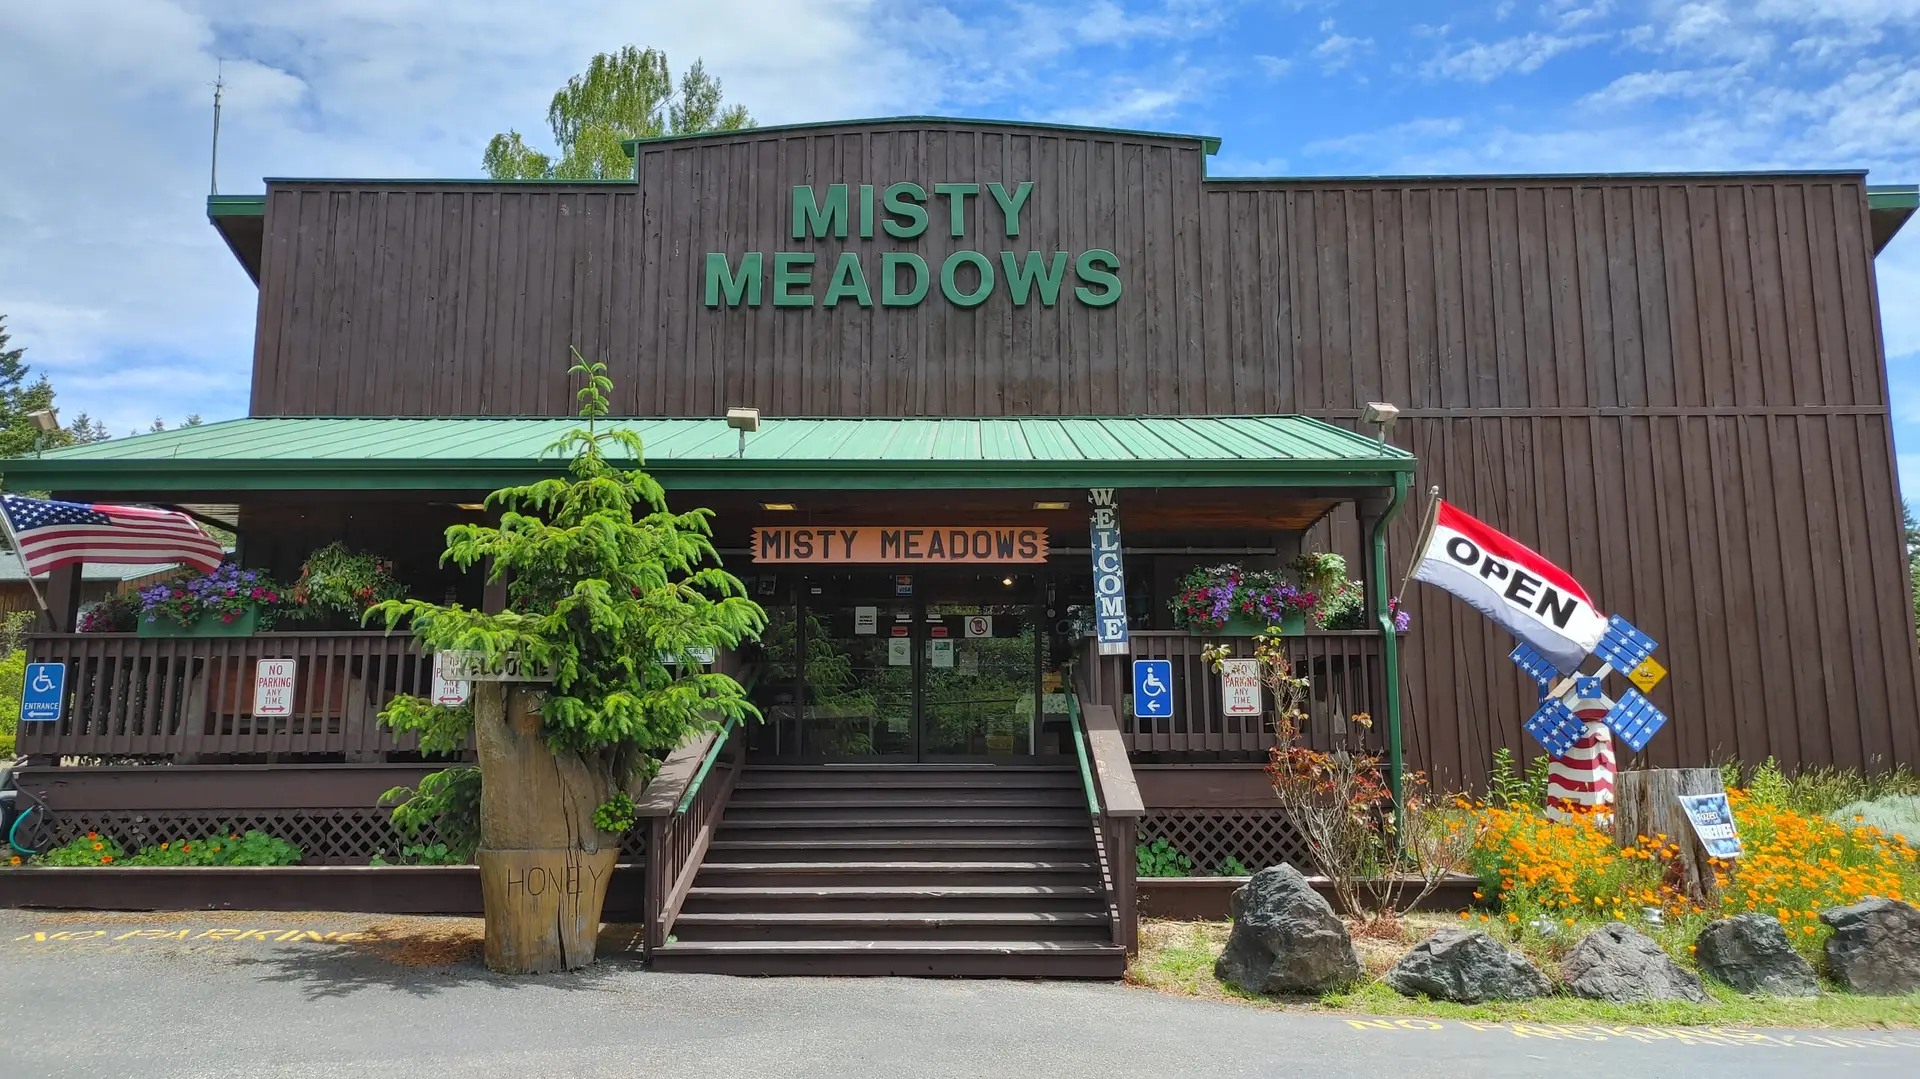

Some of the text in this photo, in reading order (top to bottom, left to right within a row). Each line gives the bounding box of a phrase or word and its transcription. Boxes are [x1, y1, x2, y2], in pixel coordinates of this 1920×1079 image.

[792, 181, 1034, 240] MISTY
[704, 248, 1122, 309] MEADOWS
[761, 530, 1039, 559] MISTY MEADOWS
[1090, 488, 1125, 640] WELCOME
[1446, 536, 1579, 629] OPEN
[268, 665, 283, 676] NO
[458, 656, 549, 677] WELCOE
[258, 677, 291, 688] PARKING
[443, 687, 460, 695] TIME
[1234, 688, 1249, 696] ANY
[24, 702, 59, 710] ENTRANCE
[264, 697, 283, 705] TIME
[1233, 696, 1251, 704] TIME
[507, 864, 607, 900] HONEY
[12, 929, 378, 943] NO PARKING
[1343, 1019, 1443, 1031] NO
